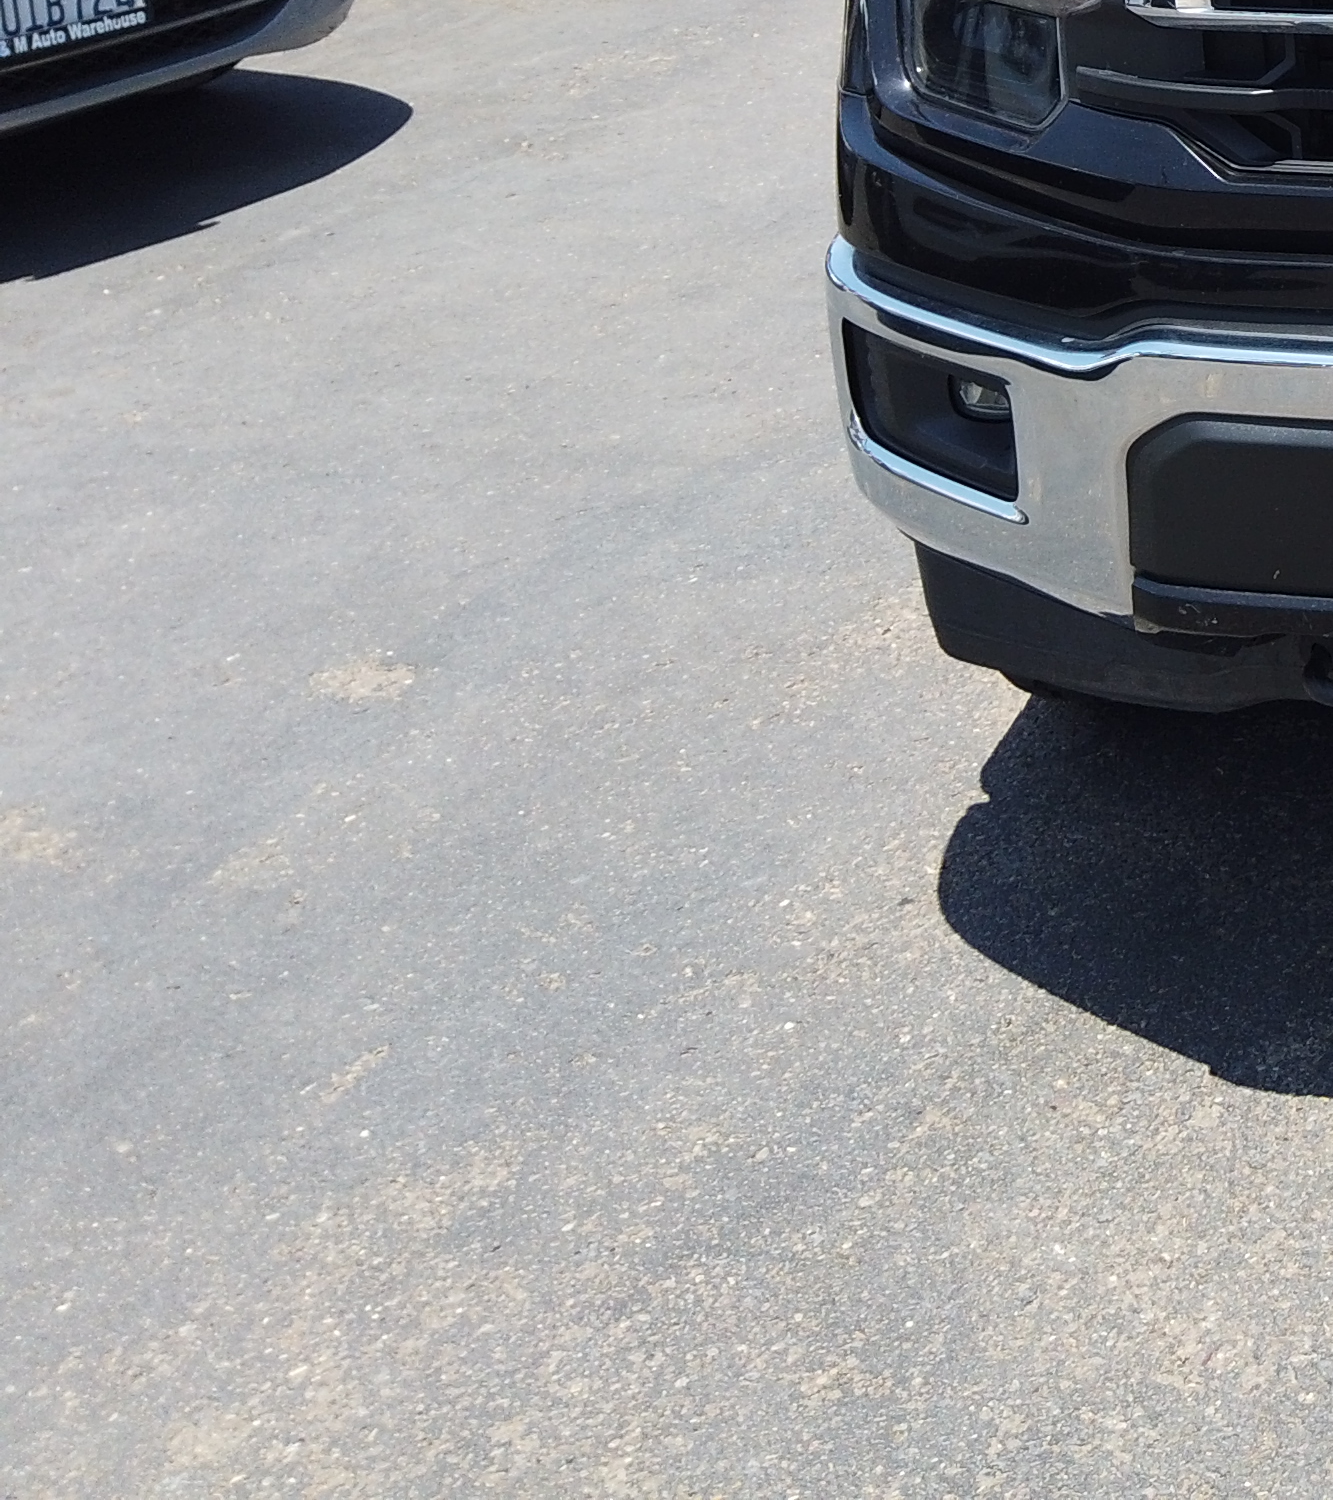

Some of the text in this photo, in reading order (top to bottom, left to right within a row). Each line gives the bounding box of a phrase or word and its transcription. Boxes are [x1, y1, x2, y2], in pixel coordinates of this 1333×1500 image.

[13, 35, 29, 54] M
[31, 29, 66, 50] Auto
[66, 10, 147, 41] Warehouse
